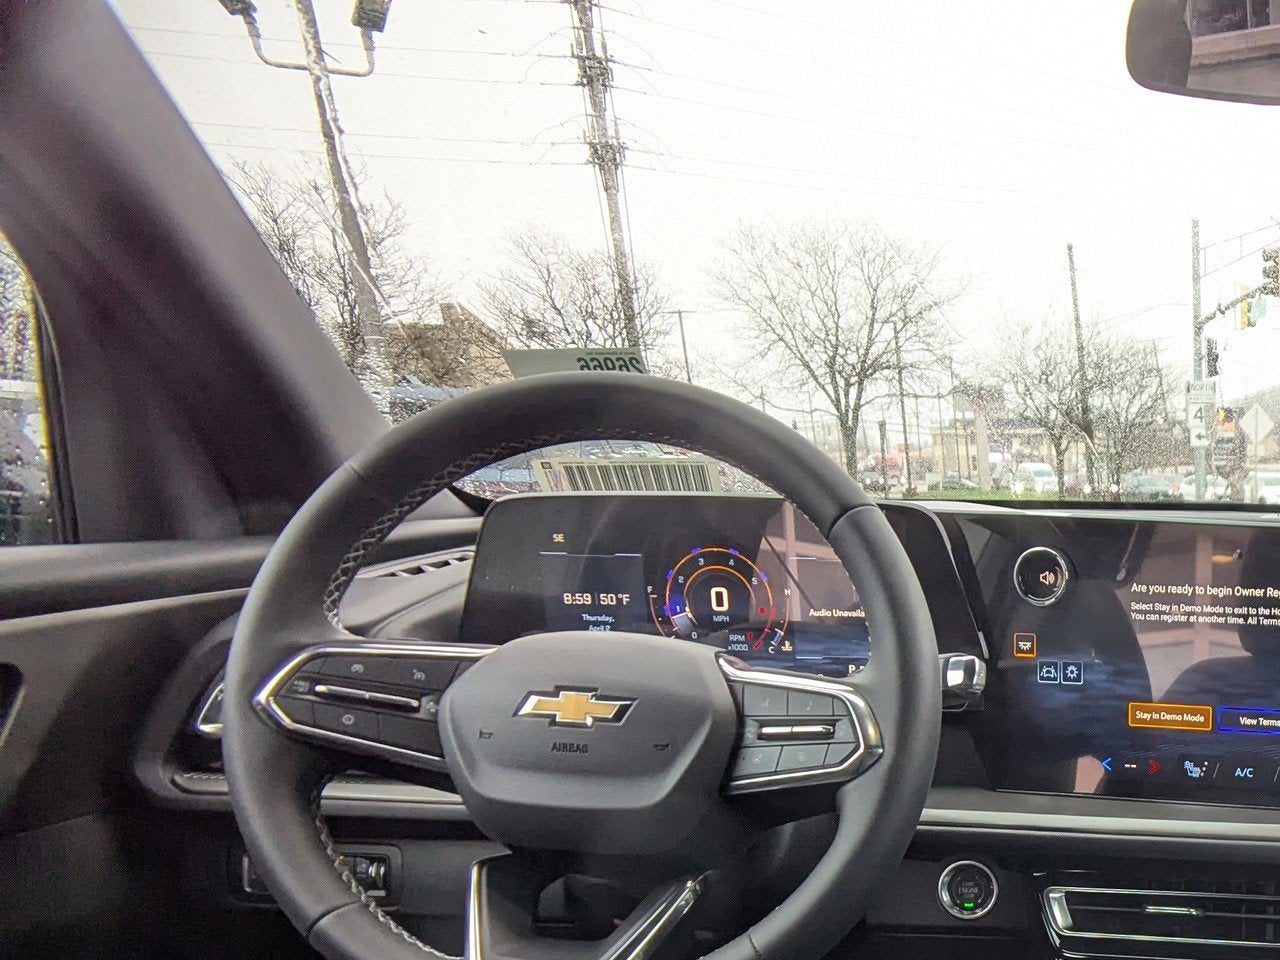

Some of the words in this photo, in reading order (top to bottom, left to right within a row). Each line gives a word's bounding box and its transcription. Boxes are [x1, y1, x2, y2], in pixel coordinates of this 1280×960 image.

[552, 533, 565, 542] SE
[698, 558, 705, 566] 3
[728, 558, 735, 566] 4
[678, 575, 684, 584] 2
[1130, 583, 1147, 593] Are
[1149, 584, 1166, 595] you
[1167, 584, 1193, 597] ready
[1195, 585, 1205, 595] to
[1207, 585, 1232, 597] begin
[1234, 586, 1265, 597] Owner
[563, 593, 592, 605] 8:59
[710, 586, 729, 612] 0
[809, 608, 831, 618] Audio
[1130, 602, 1153, 611] Select
[1154, 602, 1170, 613] Stay
[1172, 603, 1178, 611] in
[1180, 603, 1202, 612] Demo
[1203, 604, 1224, 613] Mode
[1225, 606, 1233, 614] to
[1234, 606, 1247, 615] exit
[1249, 607, 1257, 615] to
[1258, 607, 1270, 615] the
[581, 613, 615, 623] Thursday,
[1130, 612, 1144, 620] You
[1146, 613, 1159, 621] can
[1160, 613, 1187, 623] register
[1198, 615, 1226, 624] another
[1227, 615, 1245, 624] time.
[1247, 616, 1257, 625] All
[729, 634, 745, 642] RPM
[1135, 711, 1151, 721] Stay
[1160, 712, 1182, 721] Demo
[1183, 713, 1205, 722] Mode
[1239, 716, 1257, 725] View
[551, 742, 588, 754] AIRBAG
[1234, 767, 1254, 778] A/C
